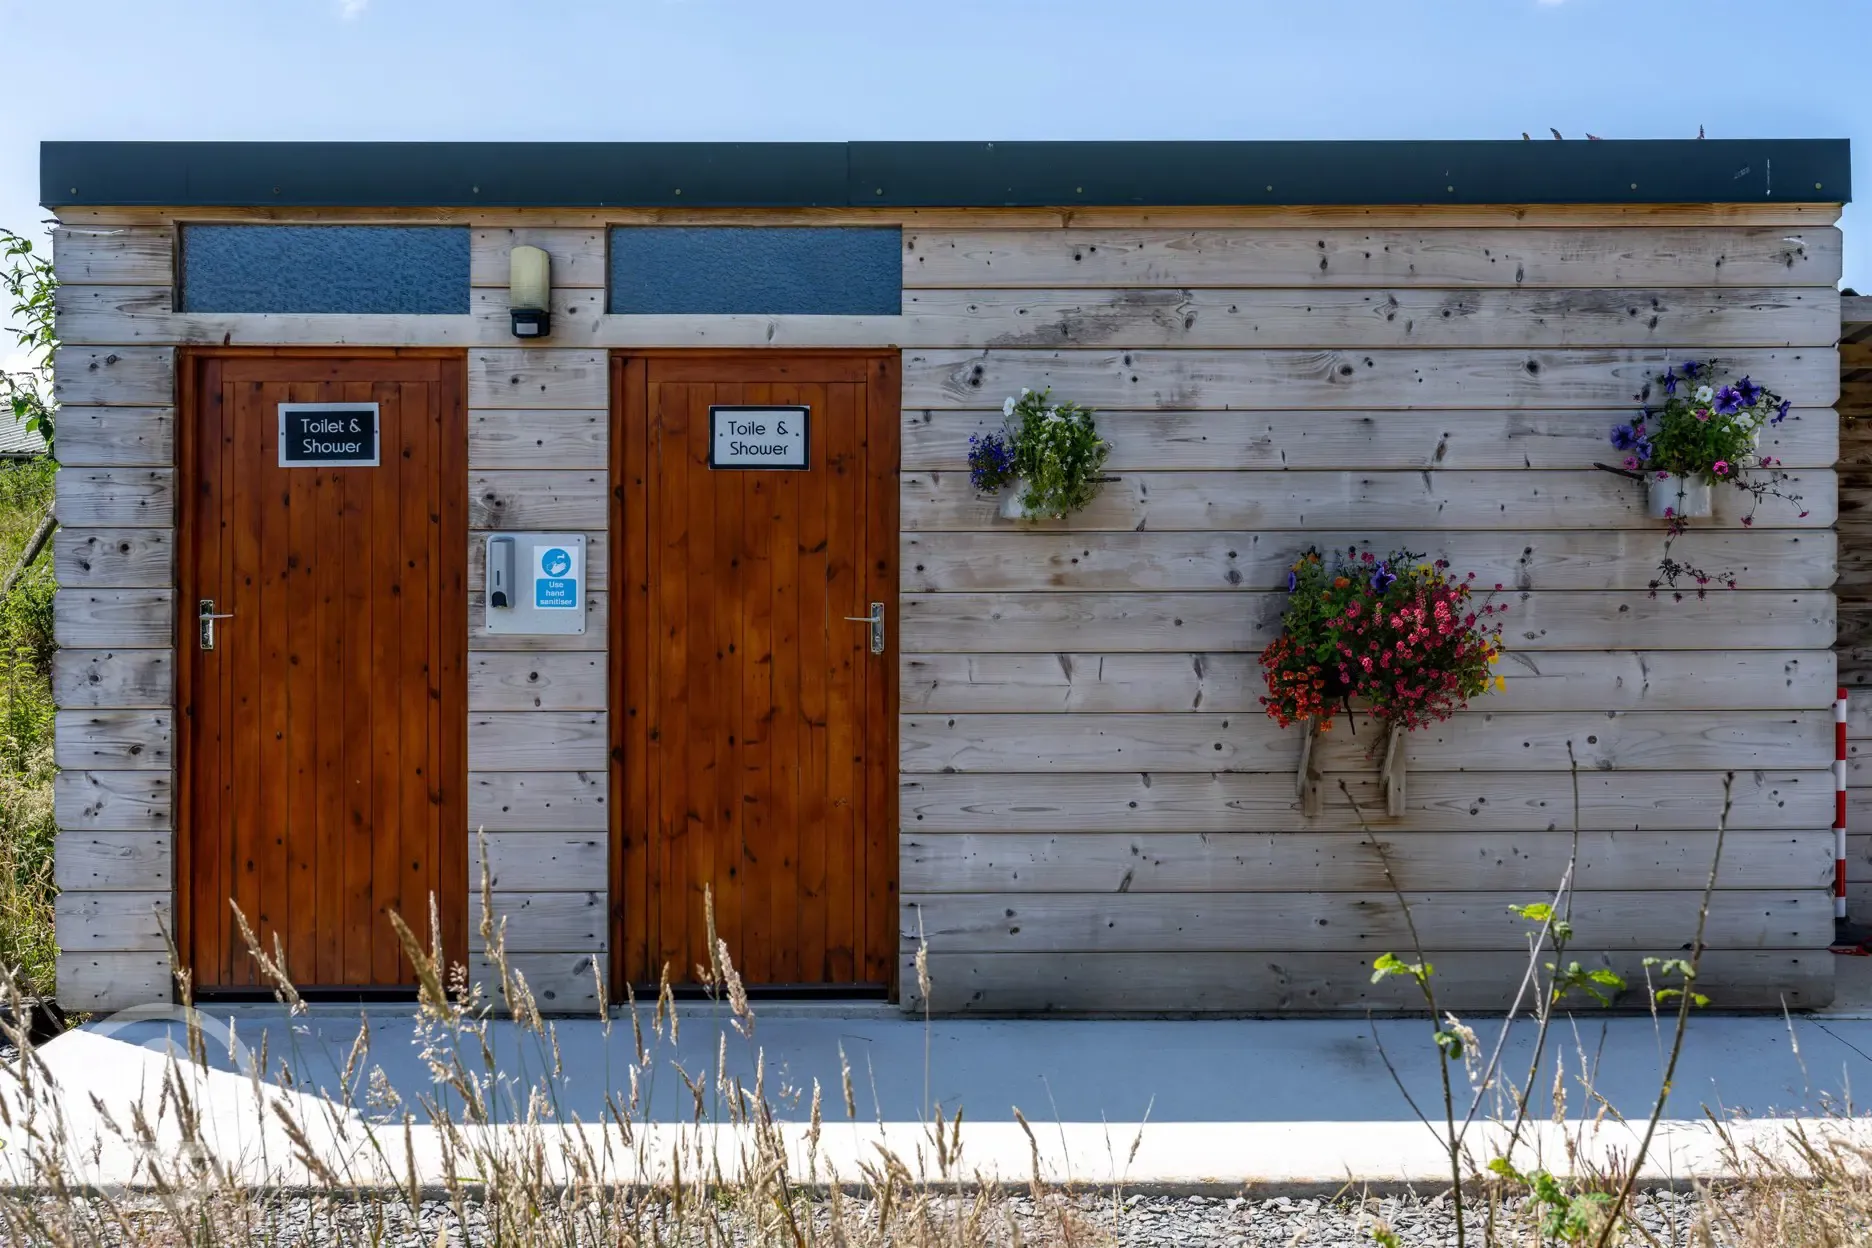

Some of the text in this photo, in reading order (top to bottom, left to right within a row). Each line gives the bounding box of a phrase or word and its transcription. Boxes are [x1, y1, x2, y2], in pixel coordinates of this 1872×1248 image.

[300, 418, 362, 433] Toilet &
[727, 420, 789, 436] Toile &
[303, 438, 362, 453] Shower
[729, 441, 789, 456] Shower
